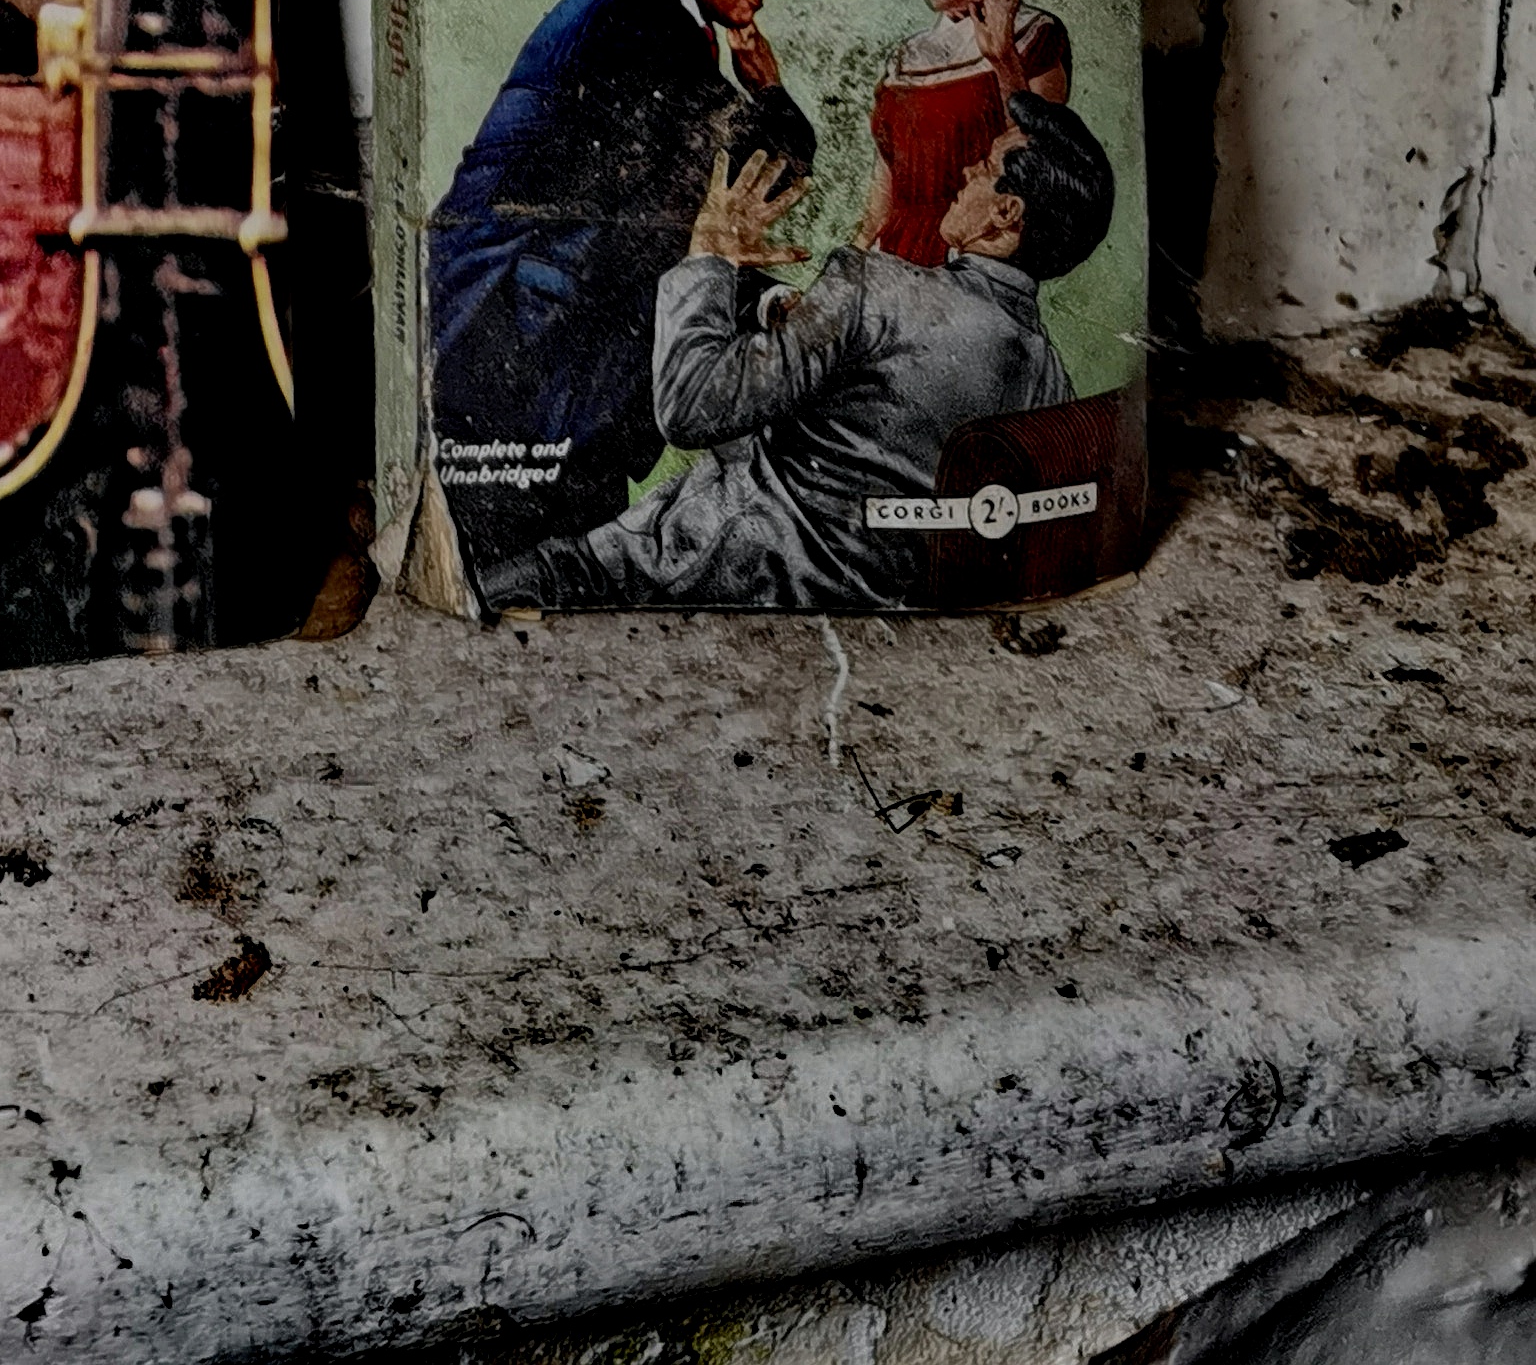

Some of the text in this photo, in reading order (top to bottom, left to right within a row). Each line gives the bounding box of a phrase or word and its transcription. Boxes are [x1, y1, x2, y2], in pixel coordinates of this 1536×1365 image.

[439, 436, 572, 463] Complete and
[439, 462, 561, 490] Unabridged
[877, 504, 954, 520] CORGI
[1031, 490, 1091, 515] BOOKS
